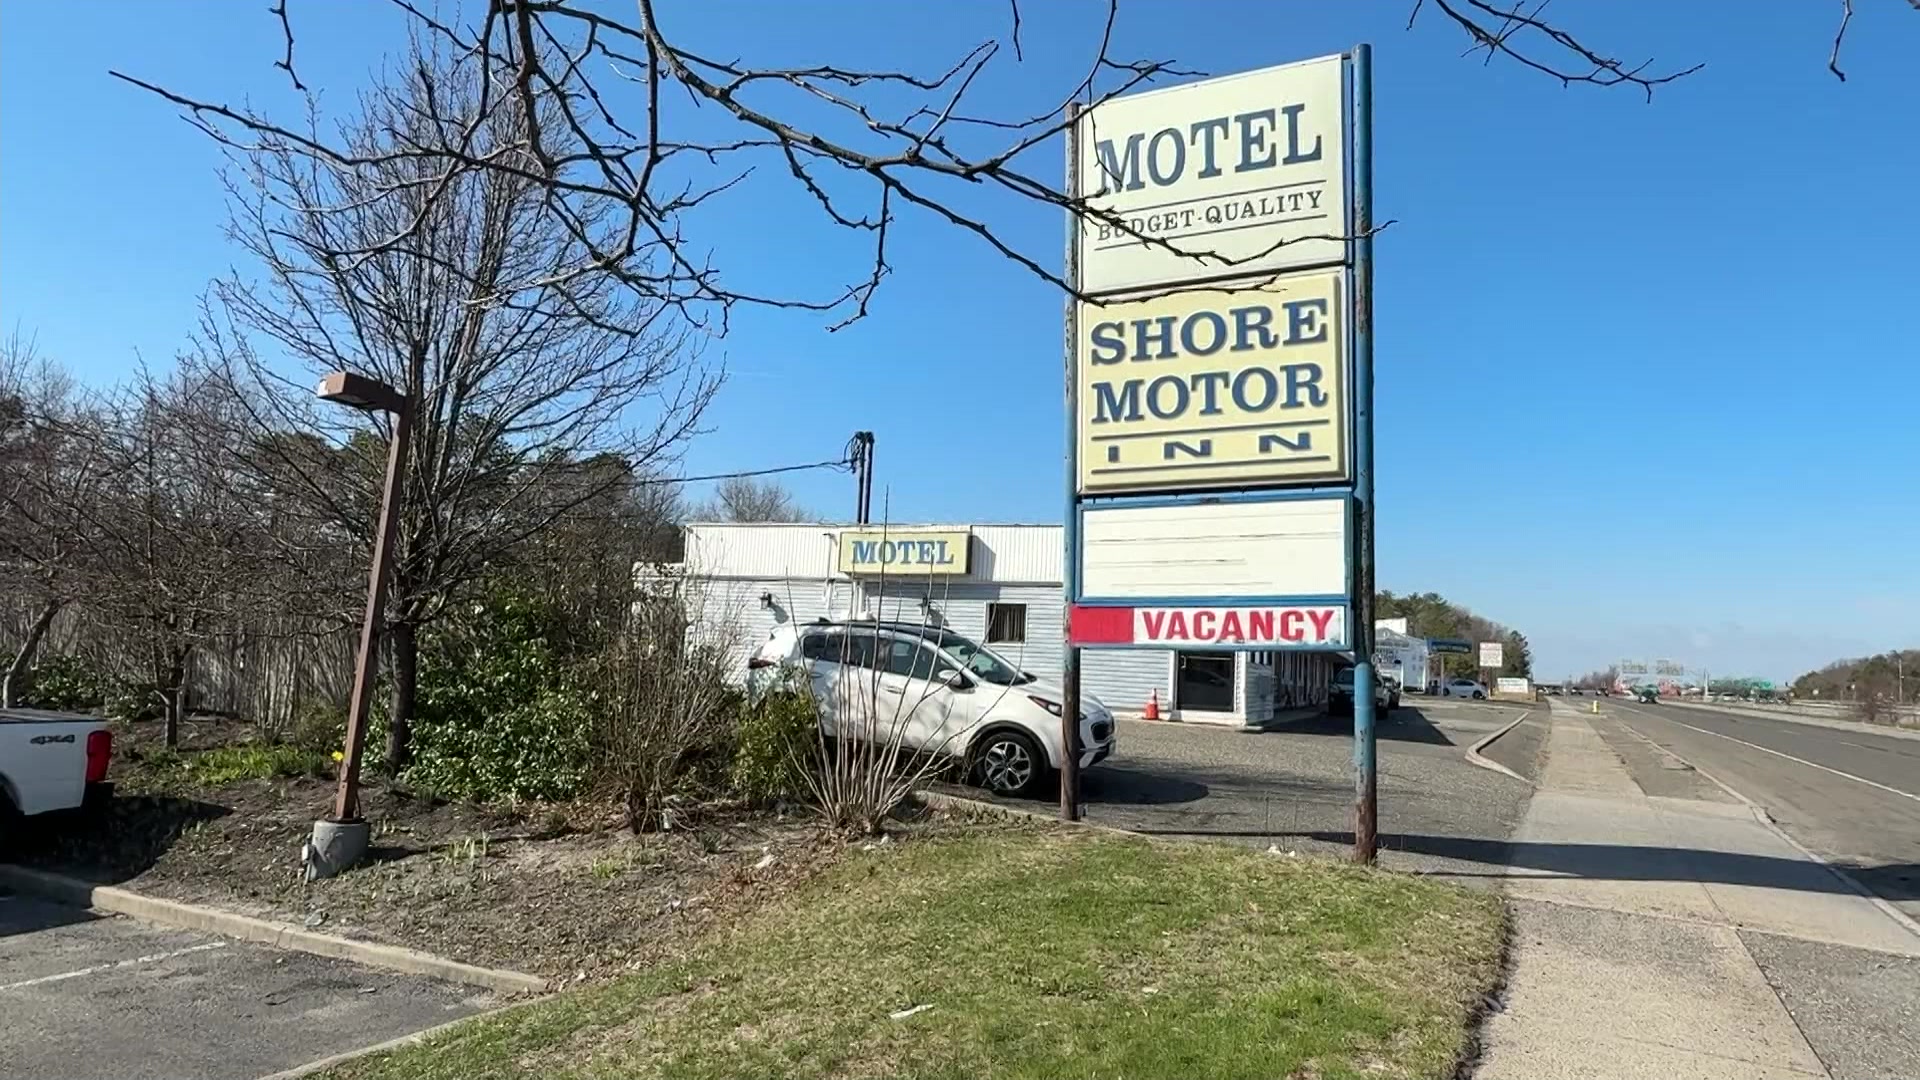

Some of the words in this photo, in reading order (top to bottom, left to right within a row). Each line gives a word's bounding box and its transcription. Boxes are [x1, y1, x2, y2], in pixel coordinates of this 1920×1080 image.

[1096, 103, 1322, 195] MOTEL
[1091, 298, 1328, 365] SHORE
[1091, 363, 1328, 423] MOTOR
[1108, 432, 1311, 463] INN
[852, 540, 954, 564] MOTEL
[1143, 610, 1334, 641] VACANCY
